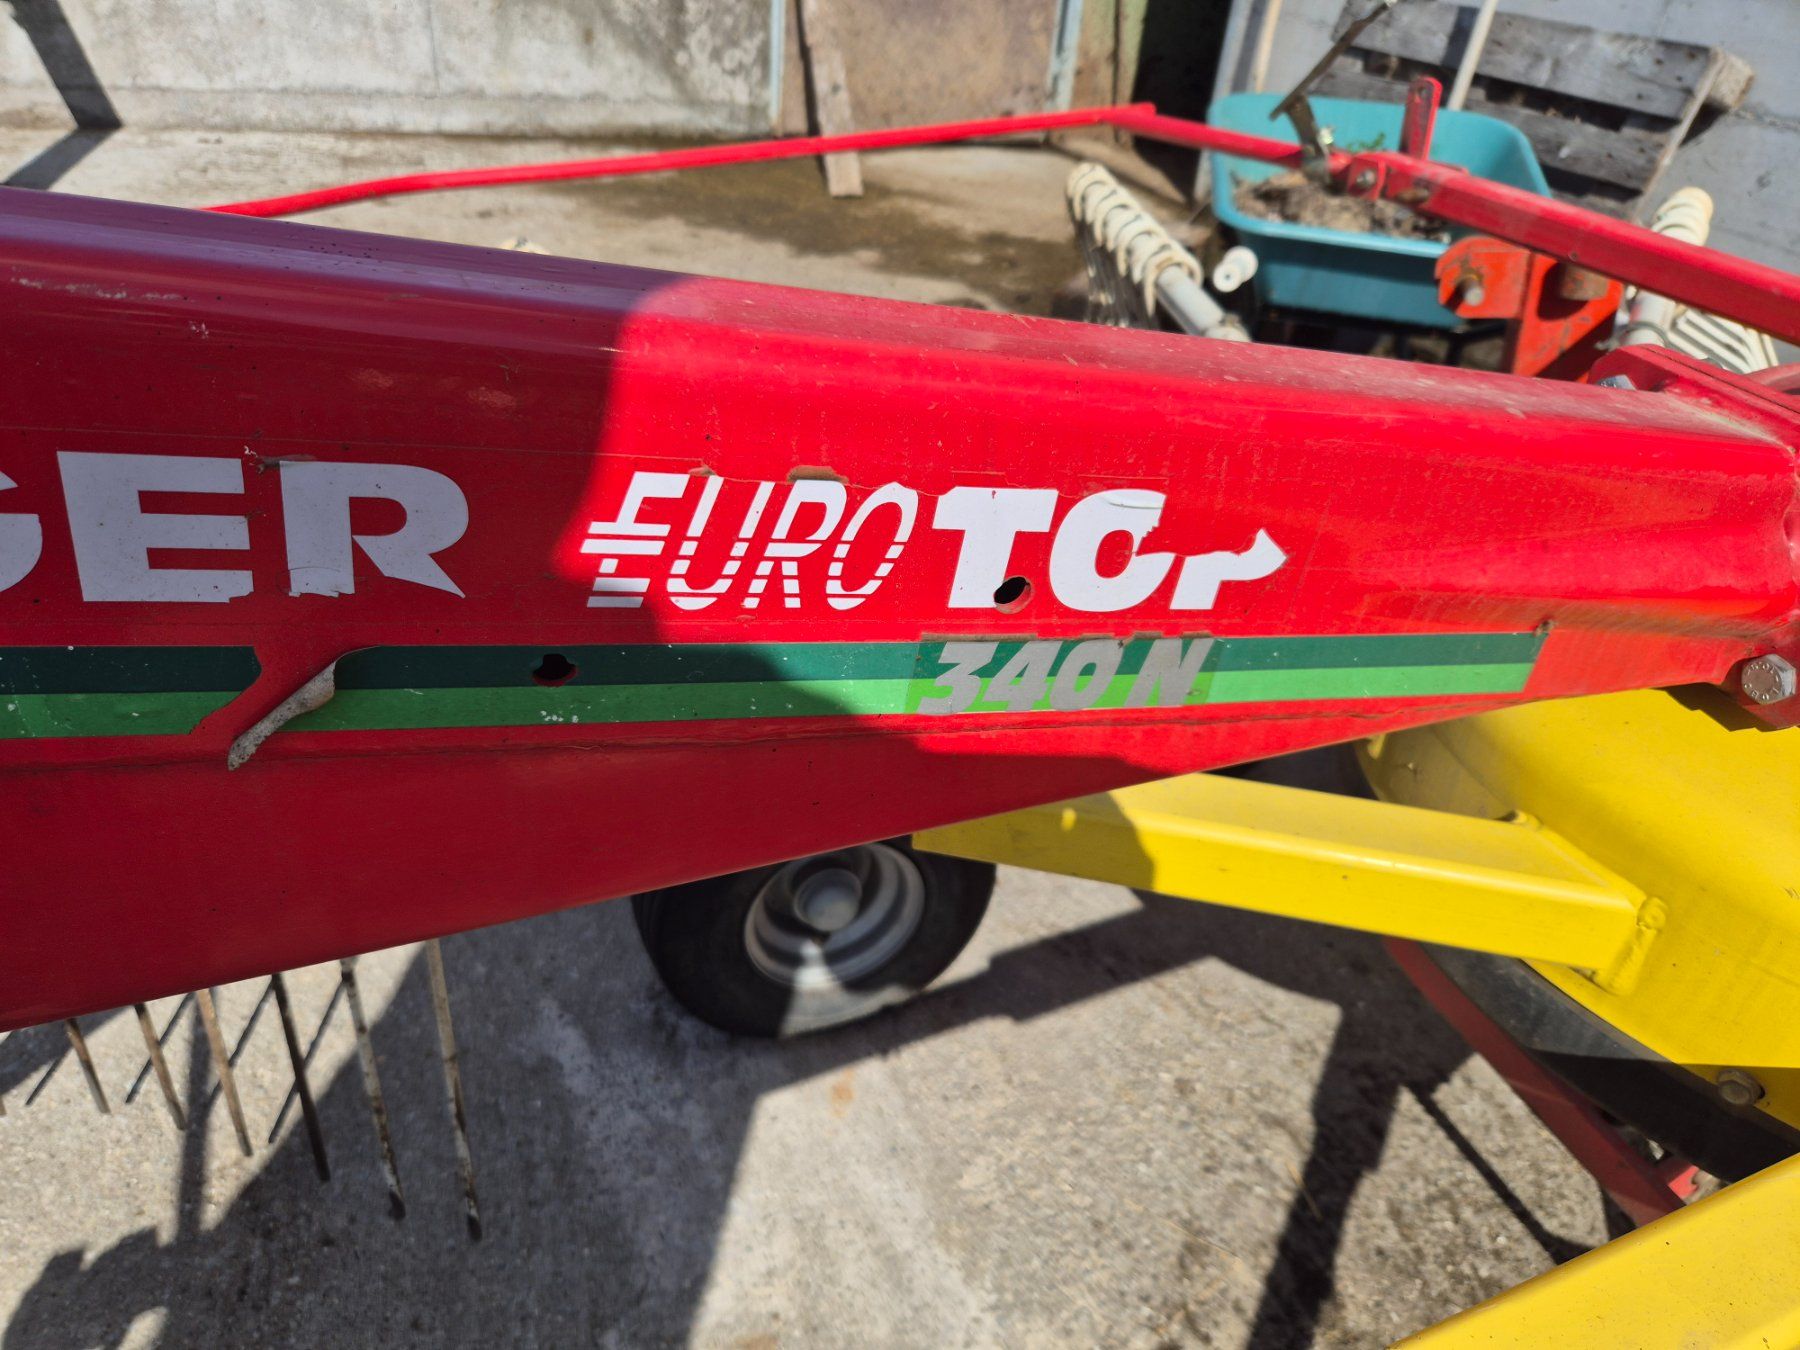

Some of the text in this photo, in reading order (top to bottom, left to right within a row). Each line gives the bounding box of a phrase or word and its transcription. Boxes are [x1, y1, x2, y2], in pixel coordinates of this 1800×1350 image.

[0, 451, 469, 603] ER
[916, 638, 1214, 715] 340 N
